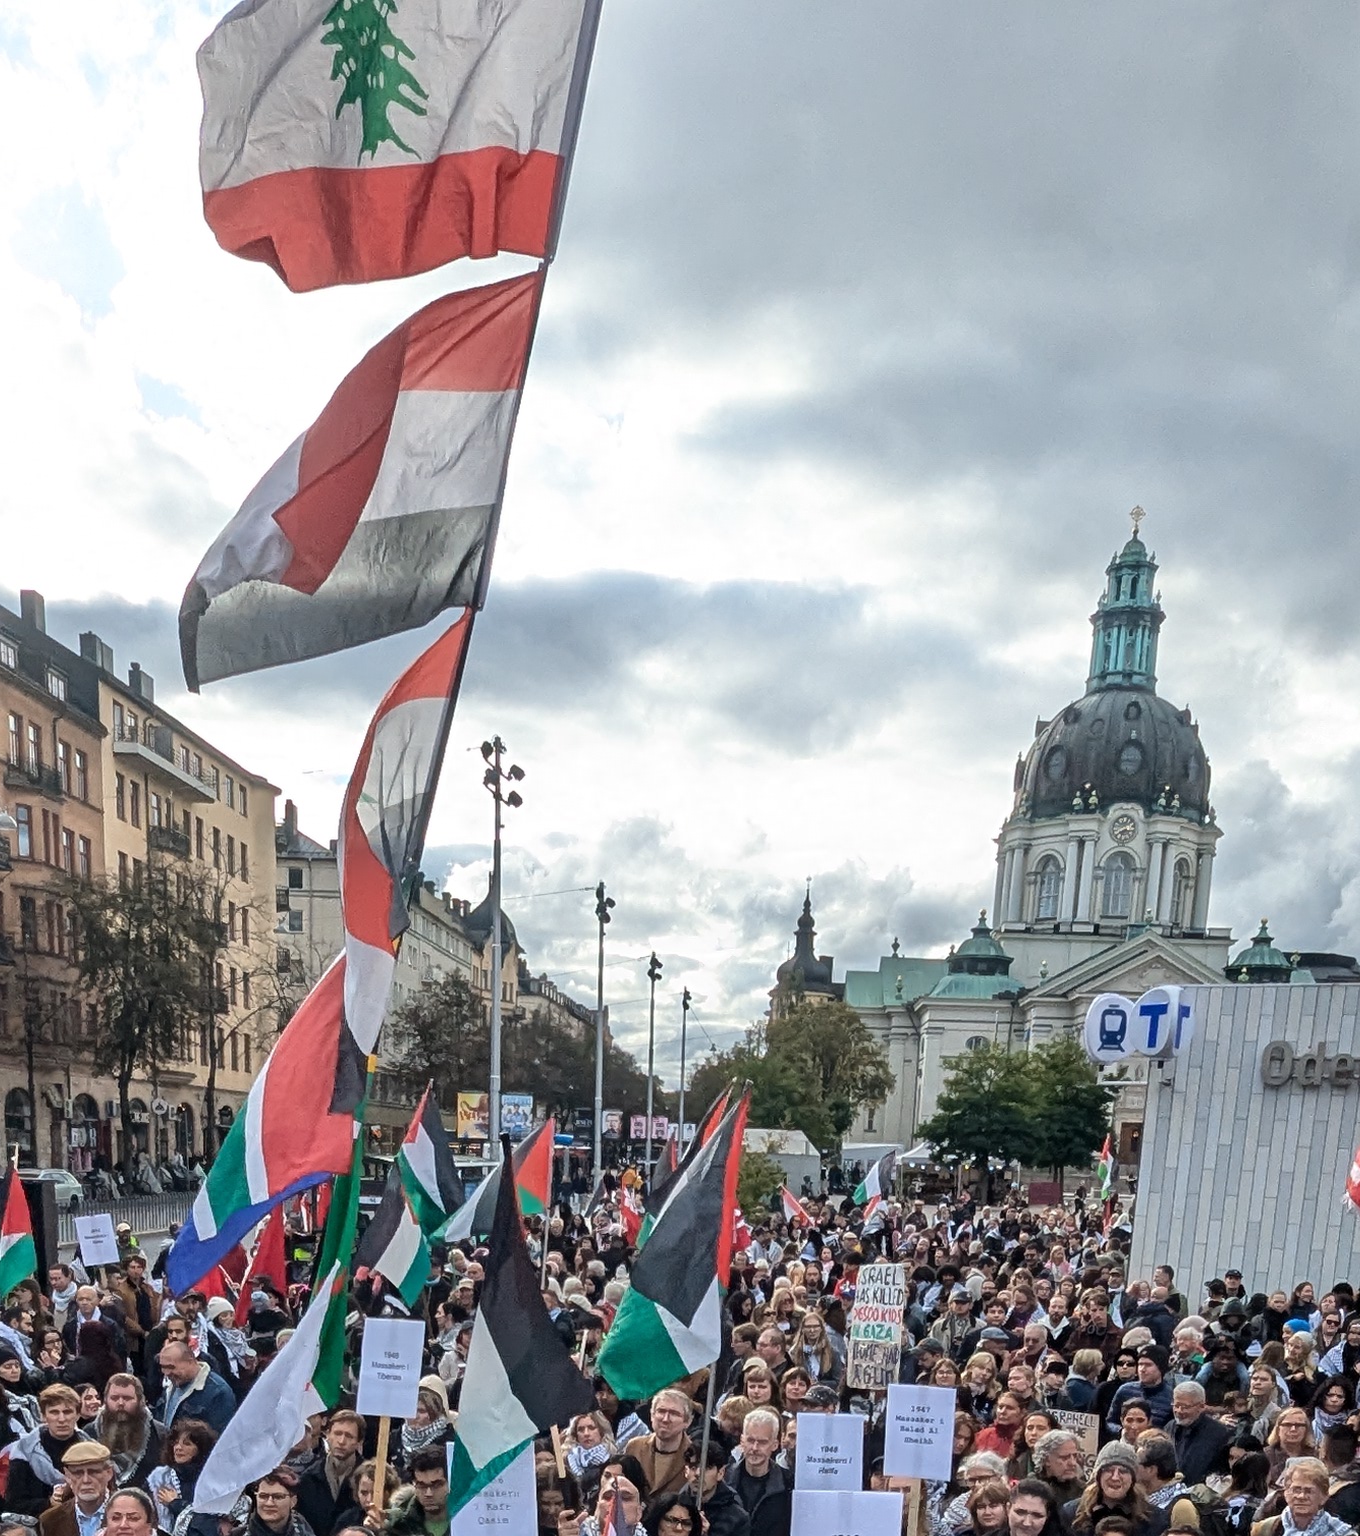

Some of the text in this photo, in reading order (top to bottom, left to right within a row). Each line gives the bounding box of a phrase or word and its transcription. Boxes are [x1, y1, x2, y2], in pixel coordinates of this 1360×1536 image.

[1139, 1003, 1169, 1049] T
[873, 1287, 904, 1306] KILLED
[881, 1308, 903, 1325] KIDS
[863, 1323, 894, 1341] GAZA
